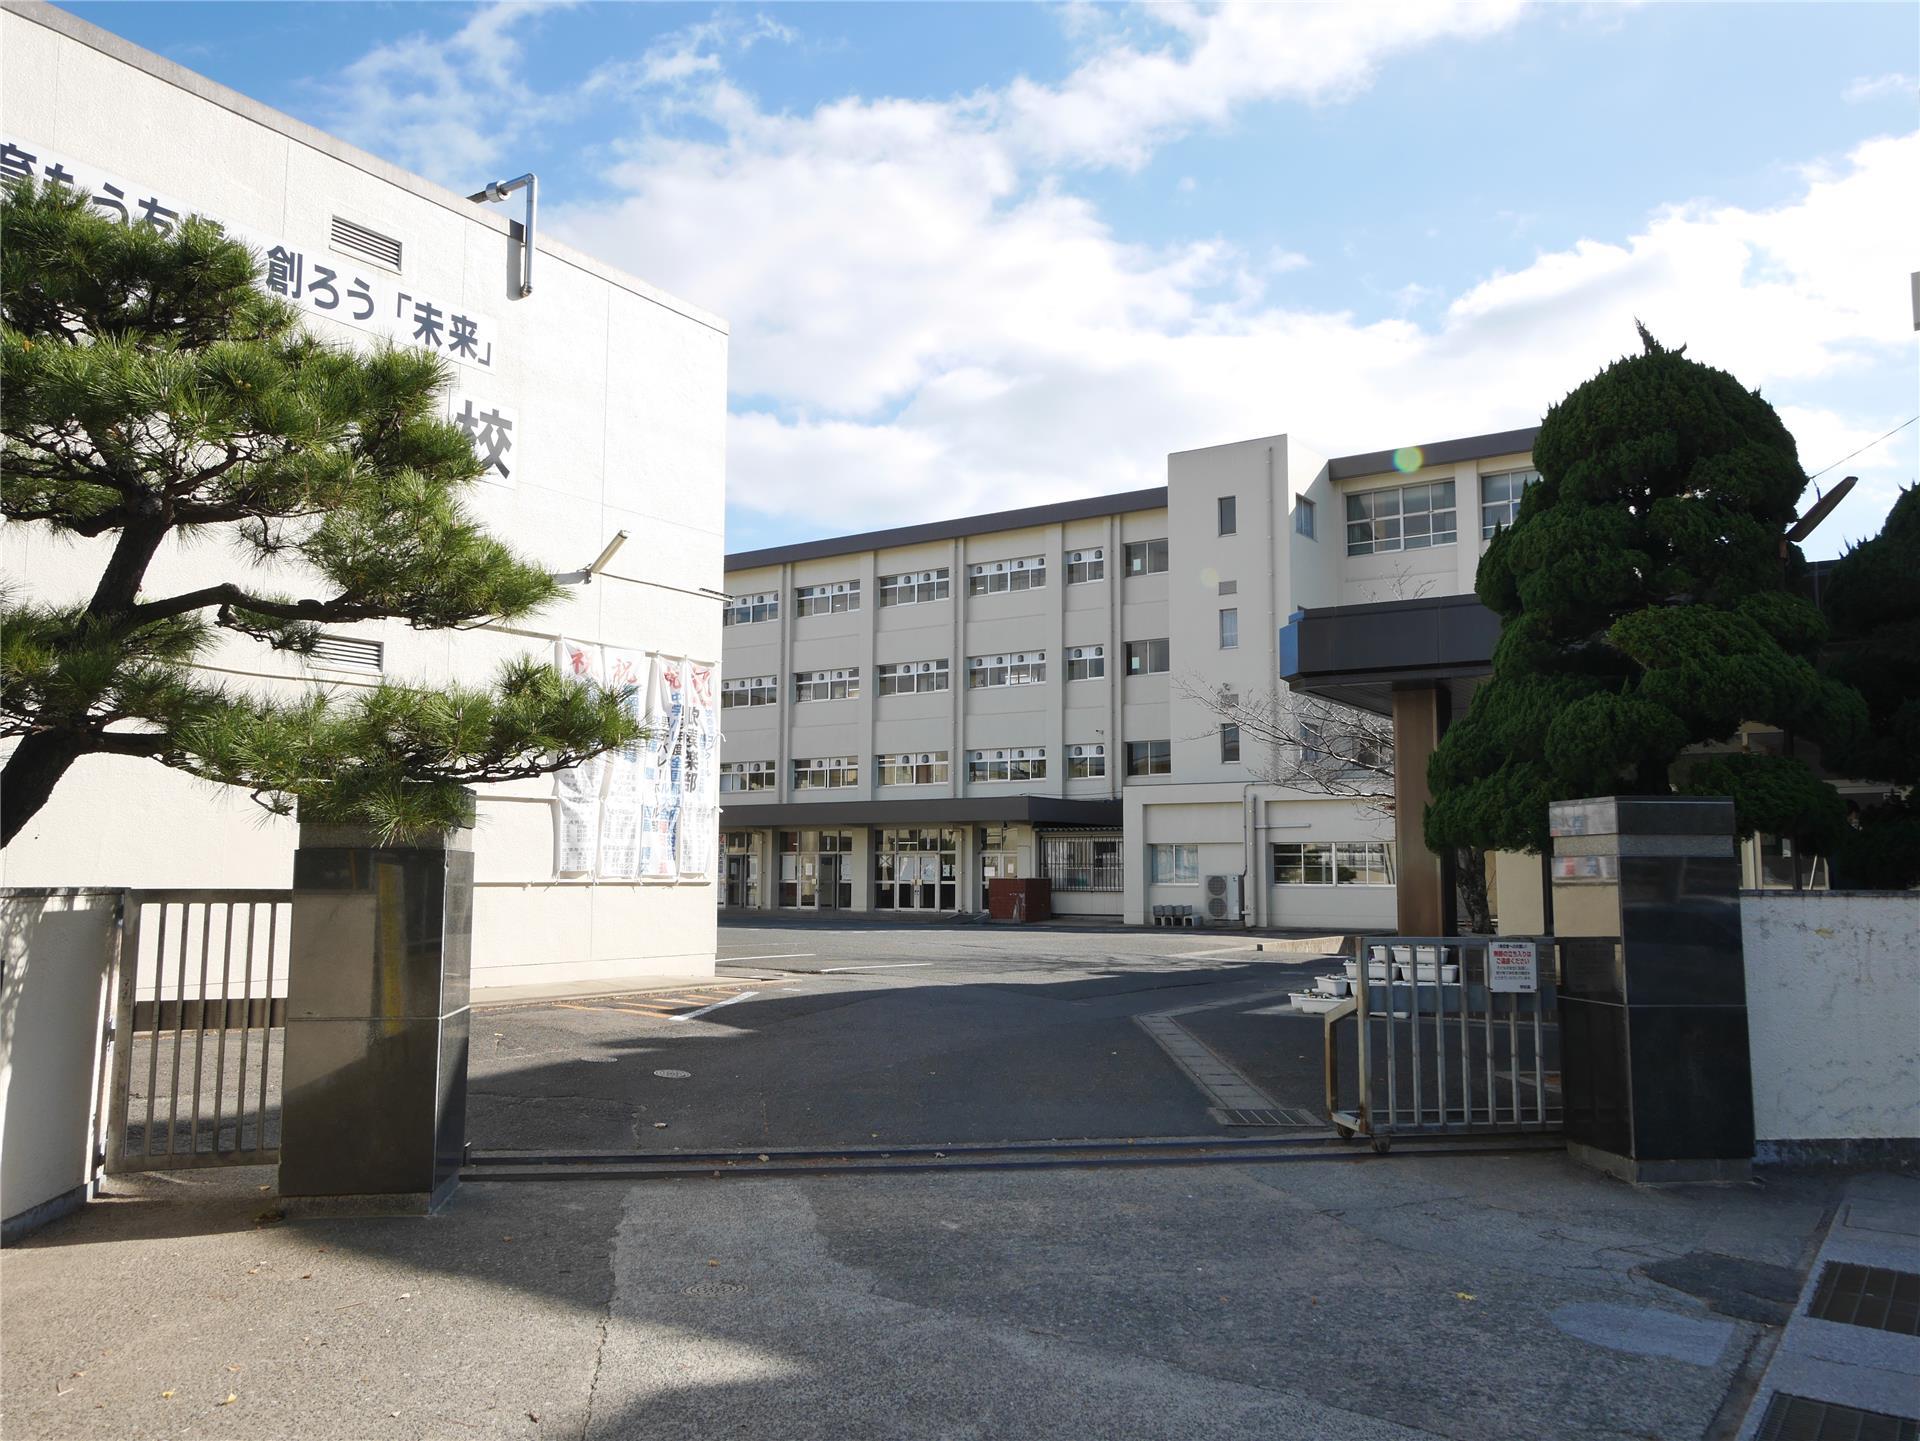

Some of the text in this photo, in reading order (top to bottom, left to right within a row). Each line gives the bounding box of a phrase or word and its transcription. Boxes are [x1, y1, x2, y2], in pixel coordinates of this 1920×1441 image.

[266, 245, 492, 367] 創ろう「未来」
[456, 400, 513, 479] 校
[684, 706, 700, 794] 吹奏楽部
